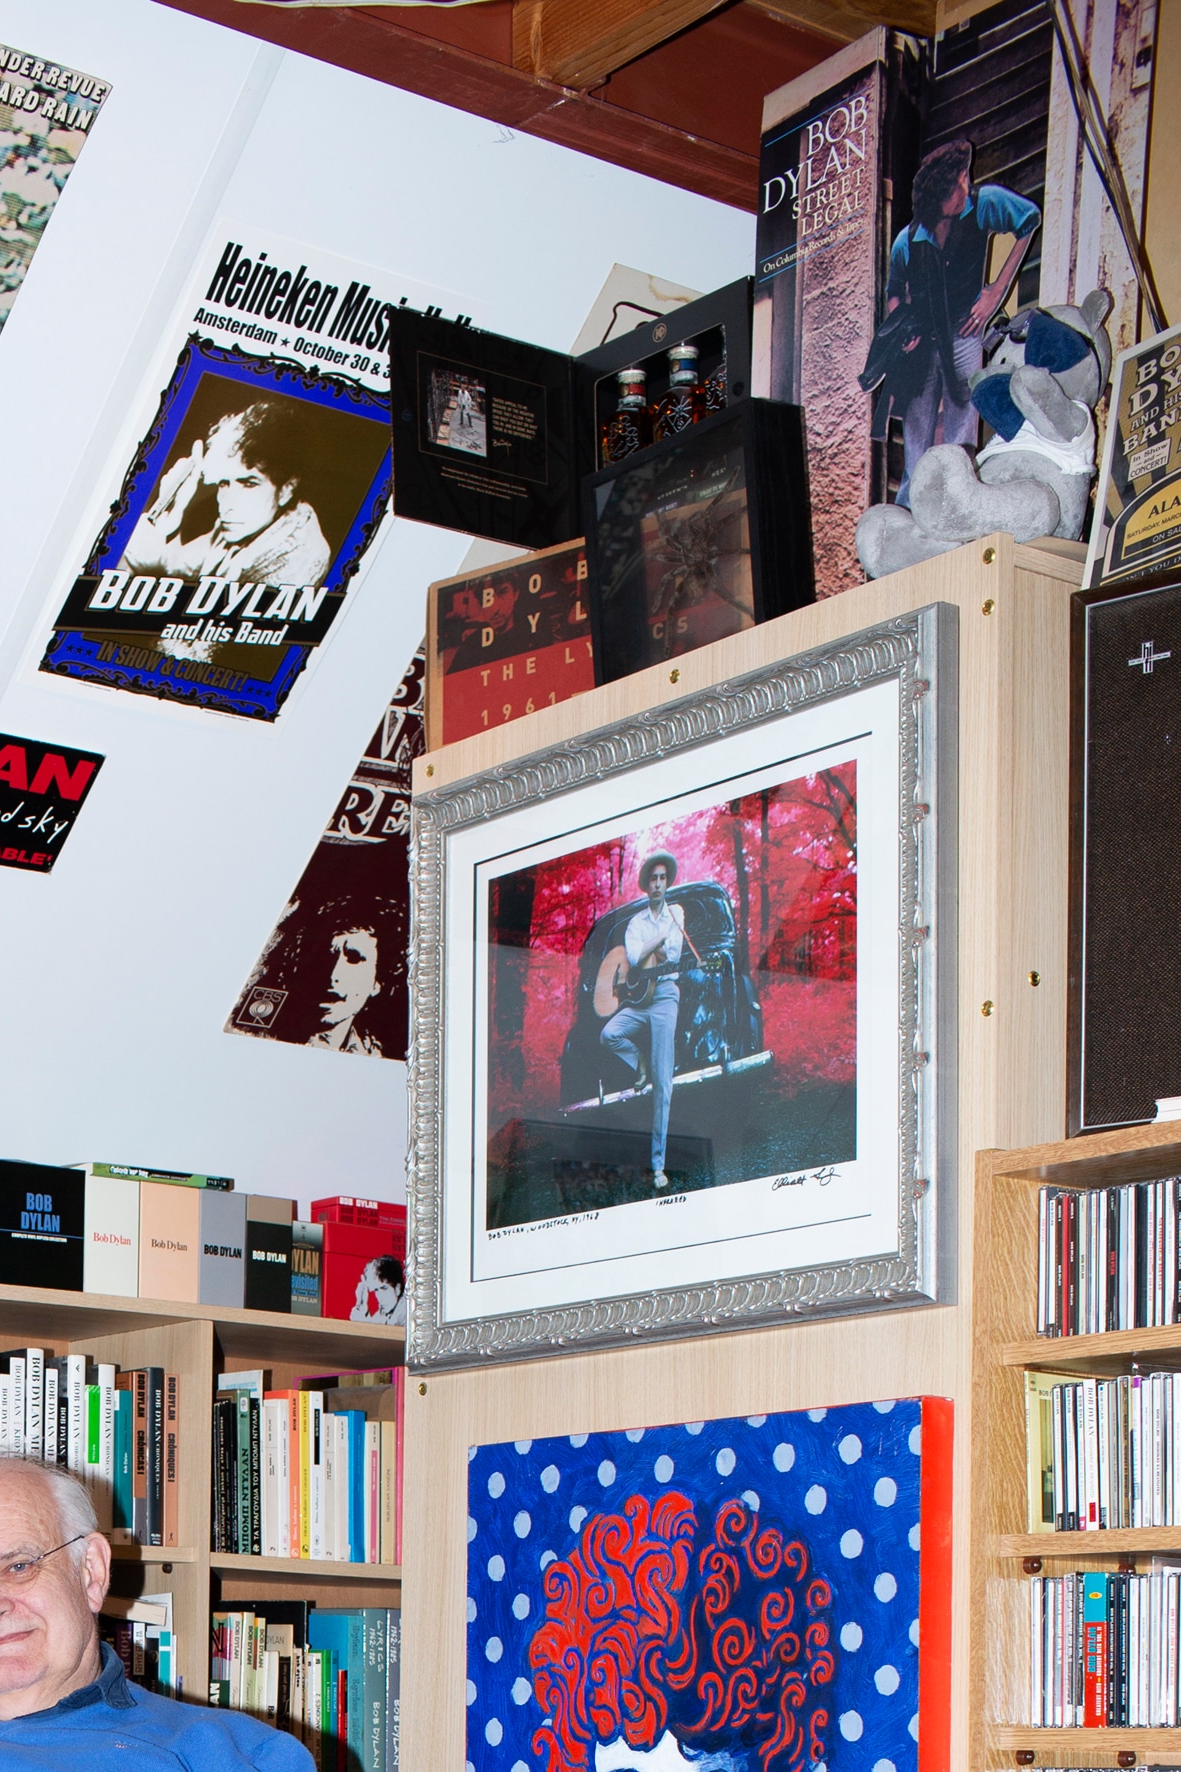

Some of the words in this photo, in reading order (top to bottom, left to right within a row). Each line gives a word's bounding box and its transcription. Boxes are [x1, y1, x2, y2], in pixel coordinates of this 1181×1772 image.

[45, 66, 106, 103] REVUE
[41, 98, 94, 130] RAIN
[806, 96, 868, 157] BOB
[763, 128, 867, 214] DYLAN
[792, 166, 865, 220] STREET
[802, 190, 865, 236] LEGAL
[763, 260, 776, 274] On
[776, 244, 809, 269] Columbia
[809, 231, 836, 252] Records
[205, 241, 339, 335] Heineken
[193, 307, 279, 346] Amsterdam
[293, 336, 350, 367] October
[350, 353, 370, 373] 30
[370, 362, 381, 377] &
[1130, 405, 1160, 432] AND
[1132, 454, 1141, 463] In
[1142, 443, 1168, 459] Show
[1143, 455, 1156, 465] and
[1130, 455, 1167, 480] CONCERT!
[1126, 519, 1161, 540] SATURDAY,
[88, 568, 184, 614] BOB
[185, 575, 329, 622] DYLAN
[160, 618, 205, 641] and
[201, 621, 233, 643] his
[234, 621, 290, 646] Band
[95, 640, 116, 662] IN
[114, 645, 162, 673] SHOW
[160, 656, 176, 675] &
[174, 657, 249, 692] CONCERT!
[23, 805, 69, 844] sky
[253, 987, 285, 1004] CBS
[26, 1192, 53, 1213] BOB
[339, 1196, 354, 1206] BOB
[355, 1199, 378, 1210] DYLAN
[20, 1211, 60, 1233] DYLAN
[92, 1232, 108, 1243] Bob
[109, 1233, 132, 1246] Dylan
[151, 1238, 166, 1249] Bob
[166, 1240, 188, 1252] Dylan
[203, 1244, 219, 1256] BOB
[219, 1246, 242, 1259] DYLAN
[252, 1250, 266, 1261] BOB
[266, 1251, 287, 1264] DYLAN
[376, 1620, 385, 1673] LYRICS
[372, 1701, 381, 1724] BOB
[371, 1727, 381, 1769] DYLAN
